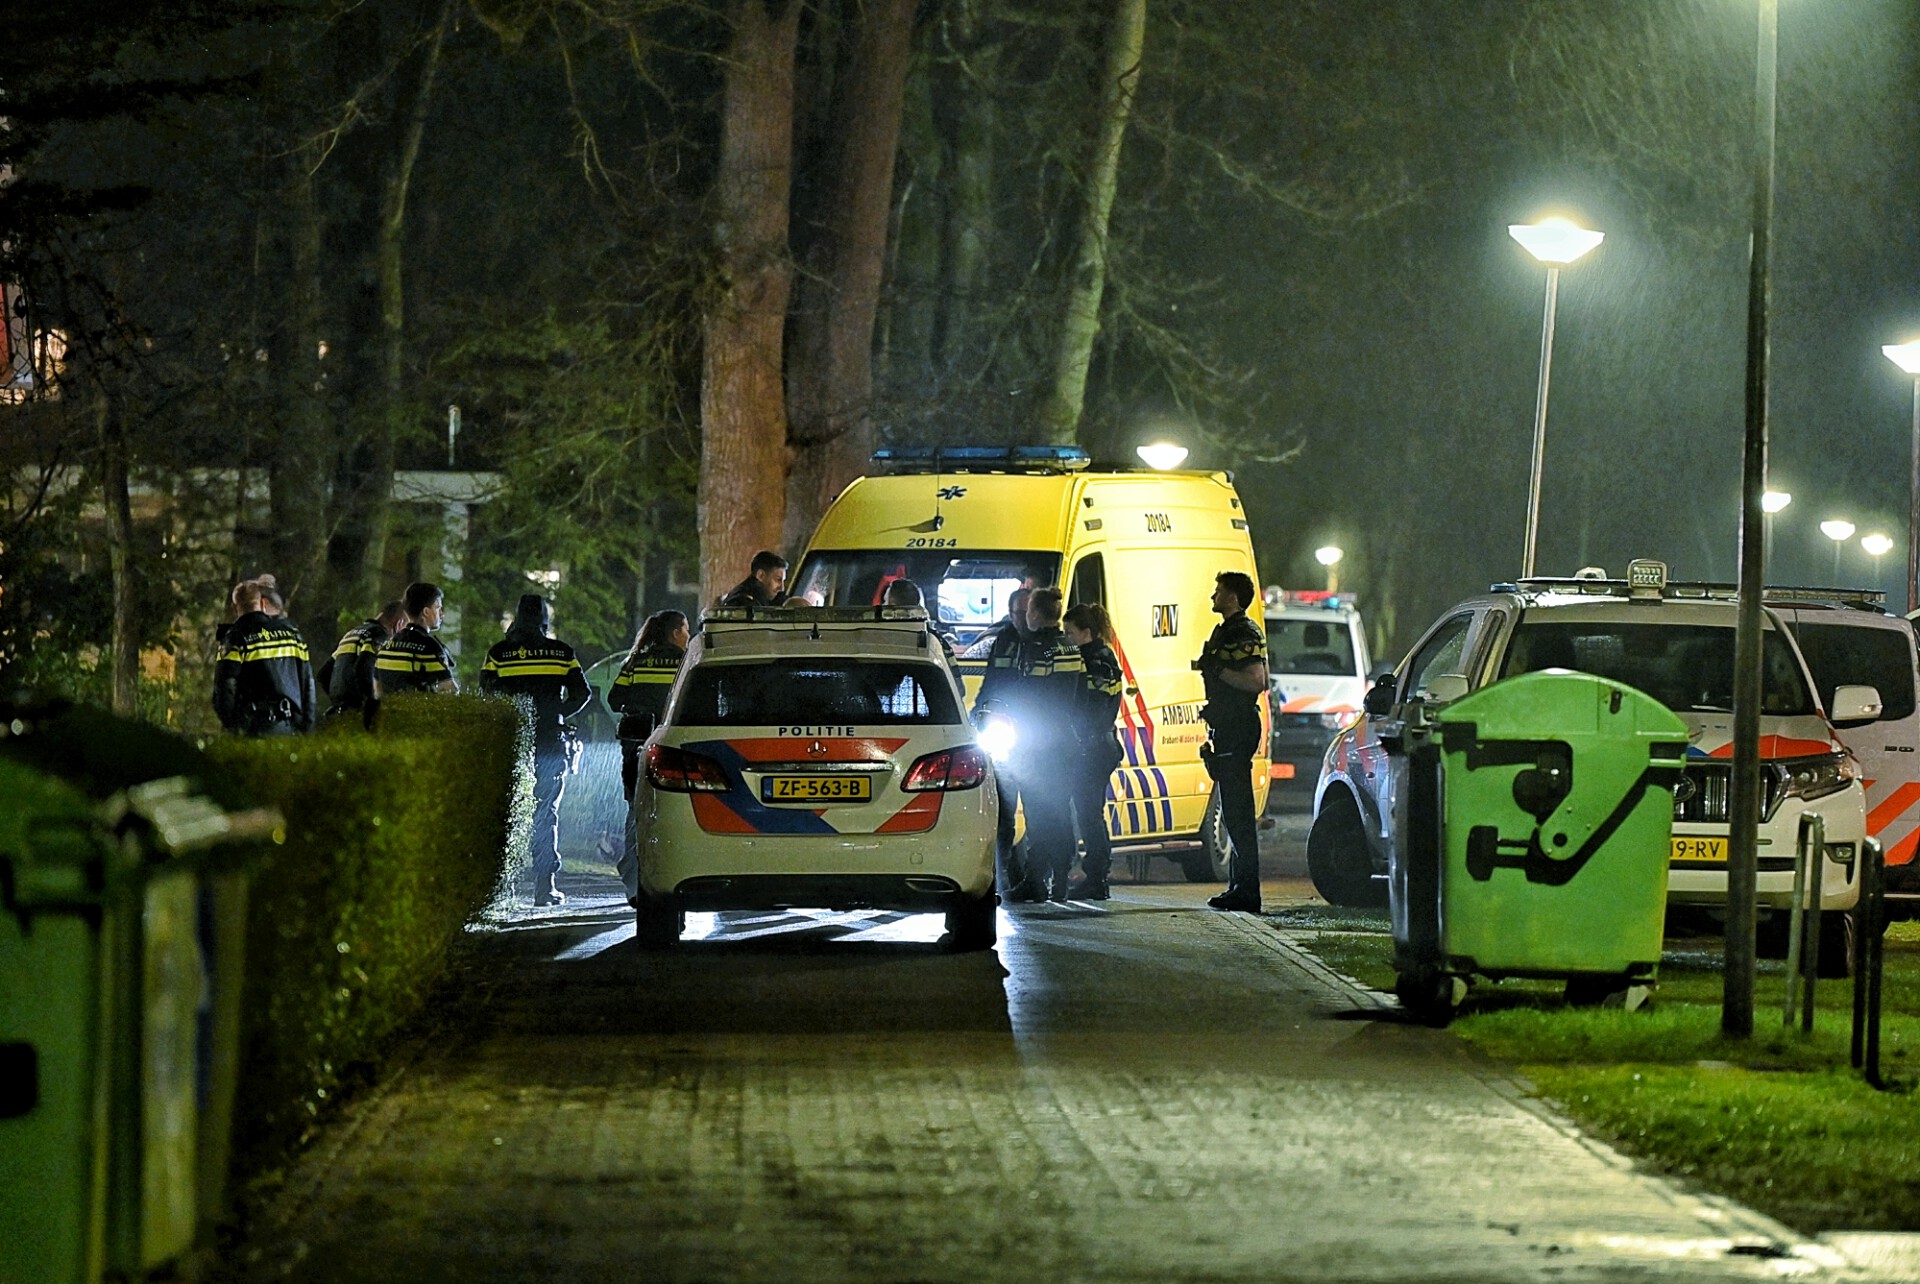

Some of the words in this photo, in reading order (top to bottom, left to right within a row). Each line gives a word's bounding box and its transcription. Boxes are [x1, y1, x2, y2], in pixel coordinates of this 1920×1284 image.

[1144, 513, 1172, 533] 20184
[906, 538, 957, 547] 20184
[1153, 605, 1178, 637] RAV
[779, 726, 854, 736] POLITIE
[780, 780, 861, 796] ZF-563-B
[1670, 841, 1721, 857] 19-RV
